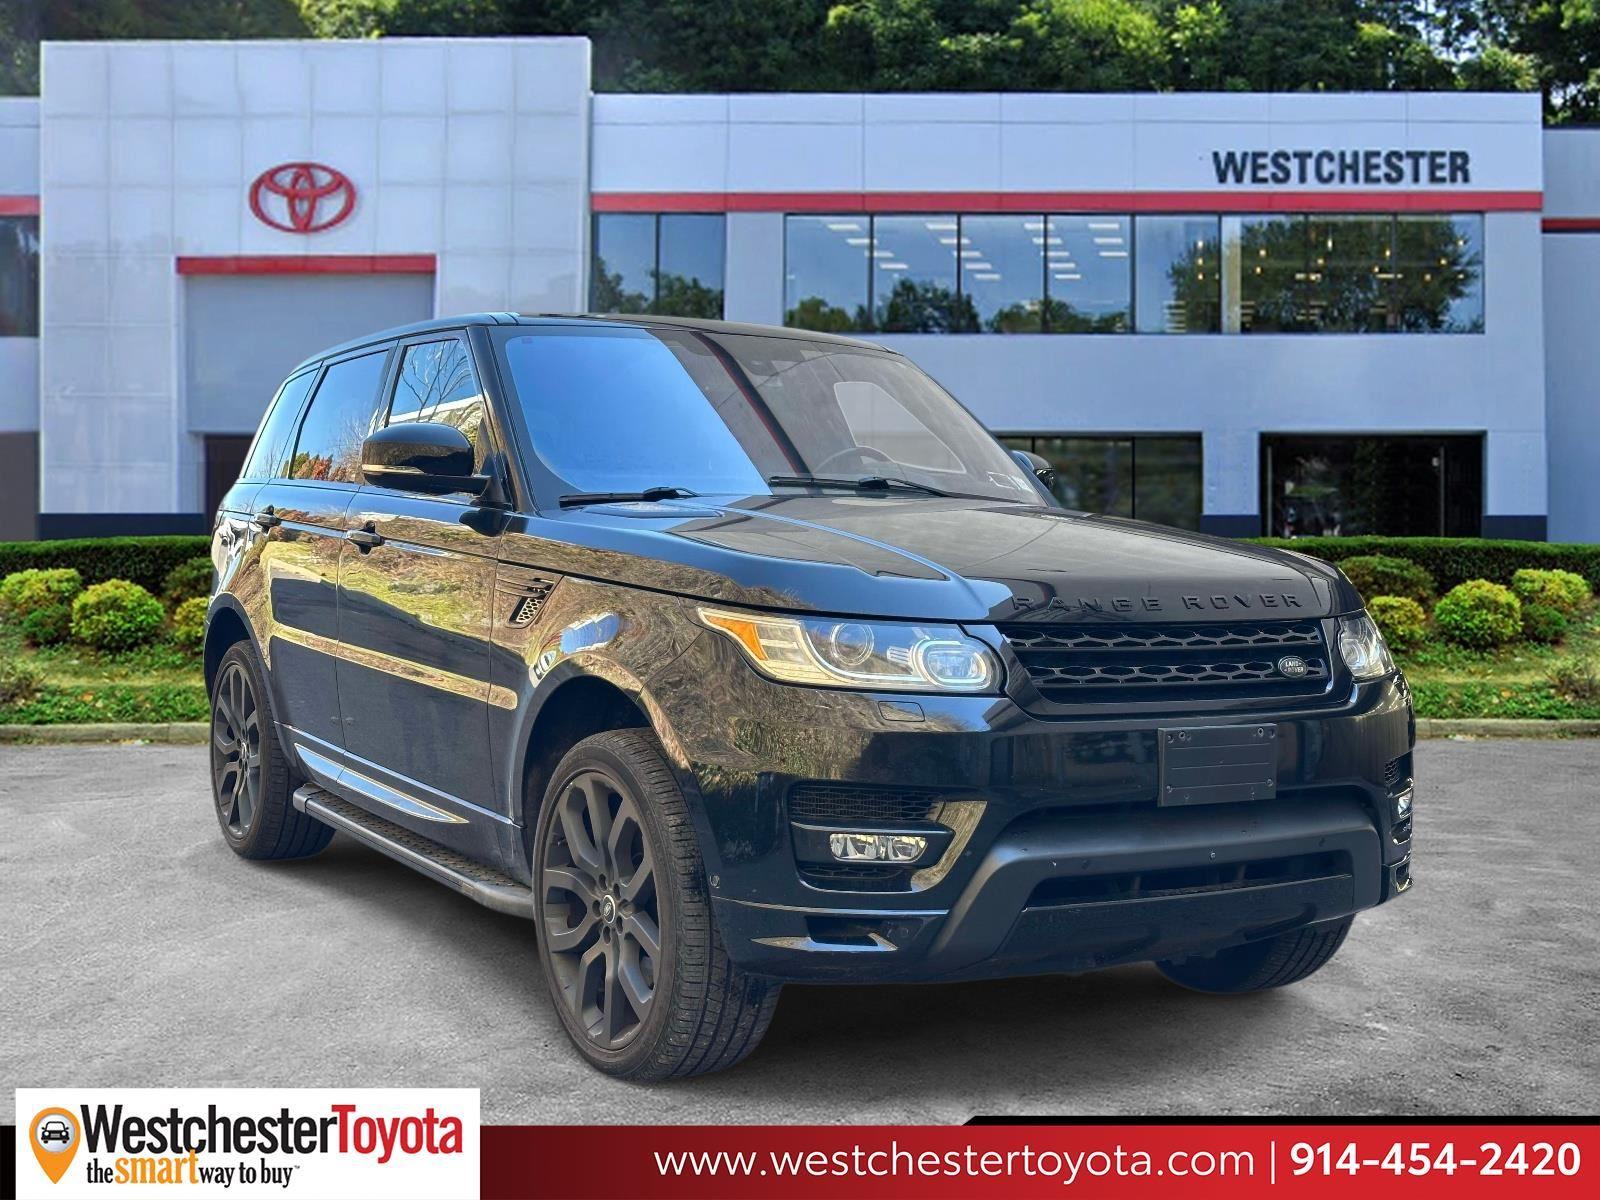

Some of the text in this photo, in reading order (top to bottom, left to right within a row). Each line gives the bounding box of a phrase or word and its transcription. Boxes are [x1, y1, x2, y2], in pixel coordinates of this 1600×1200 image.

[1212, 150, 1470, 184] WESTCHESTER
[1013, 593, 1304, 613] RANGE ROVER
